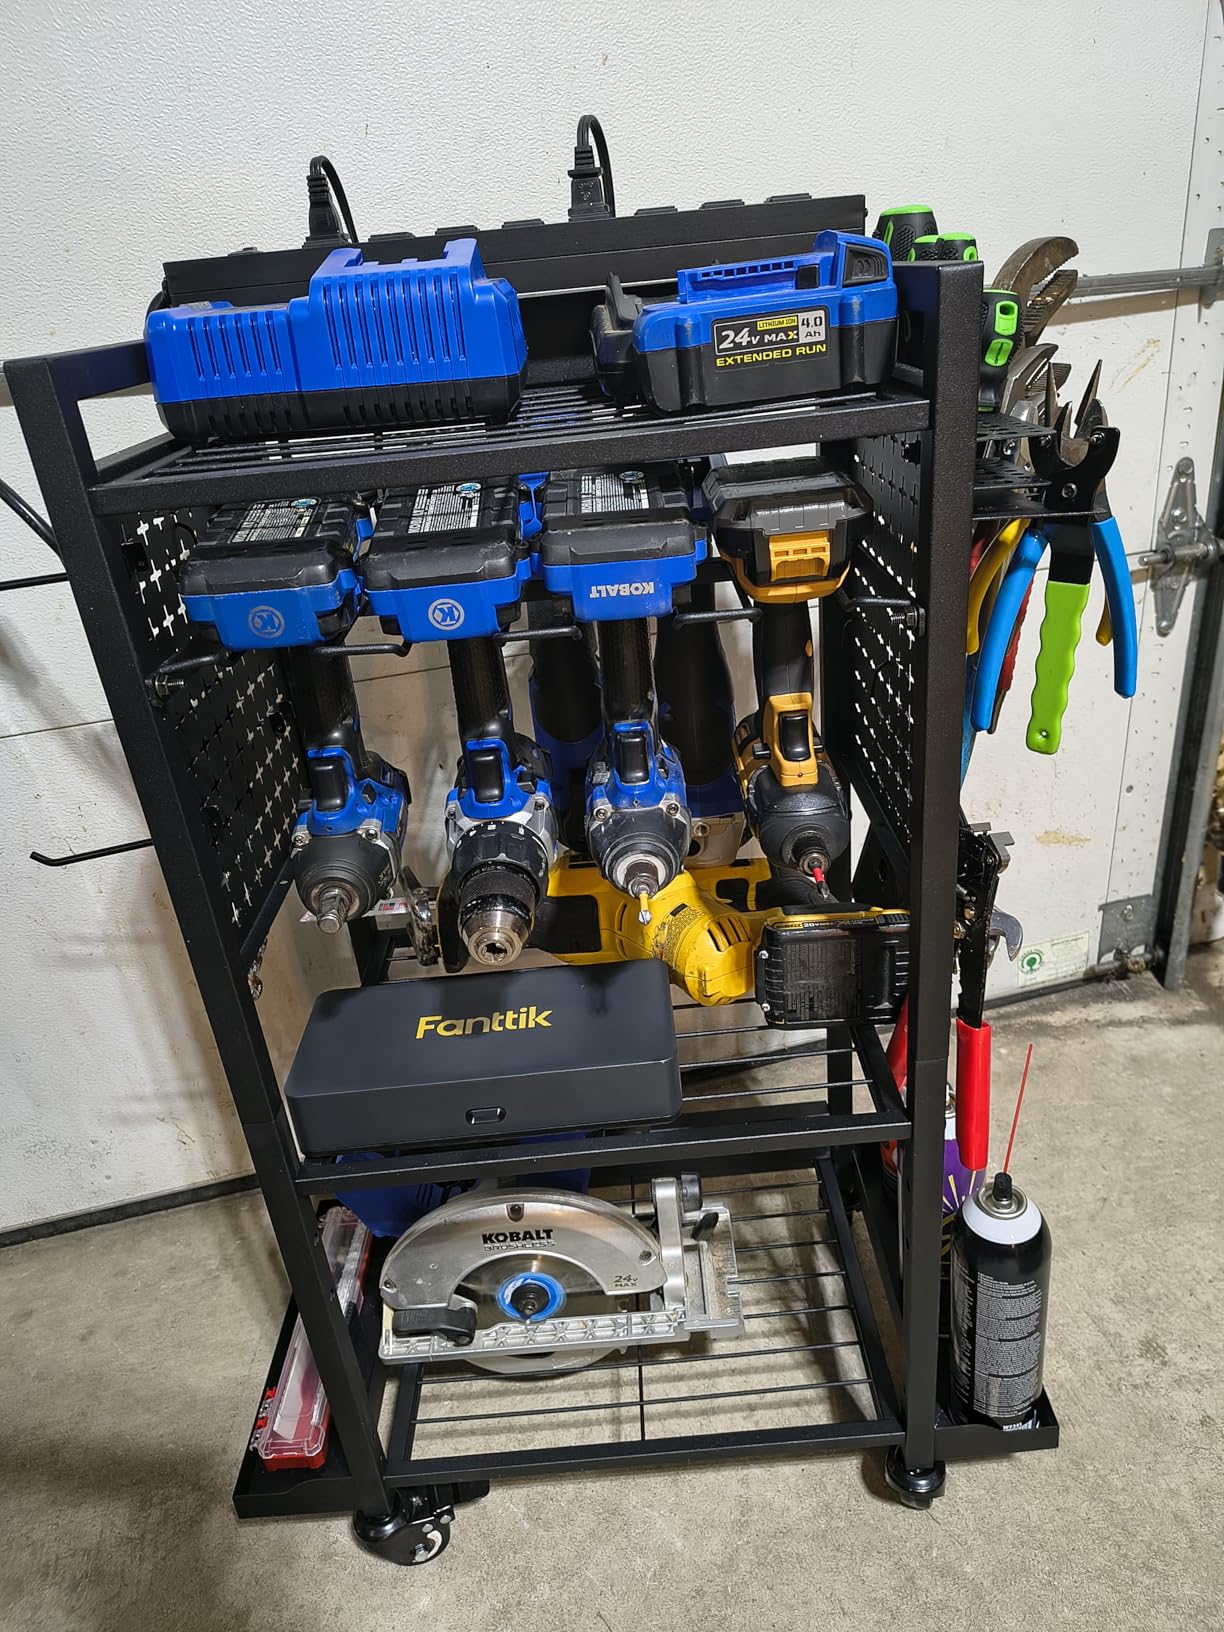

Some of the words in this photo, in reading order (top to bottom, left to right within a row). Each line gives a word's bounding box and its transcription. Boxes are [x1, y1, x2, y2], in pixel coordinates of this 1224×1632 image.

[758, 317, 785, 329] LITHIUM
[785, 317, 797, 326] ION
[801, 316, 823, 328] 4.0
[764, 330, 798, 343] MAX
[804, 330, 821, 339] Ah
[716, 348, 792, 367] EXTENDED
[796, 343, 827, 356] RUN
[589, 581, 655, 599] KOBALT
[415, 1006, 553, 1039] Fanttik
[482, 1229, 554, 1244] KOBALT
